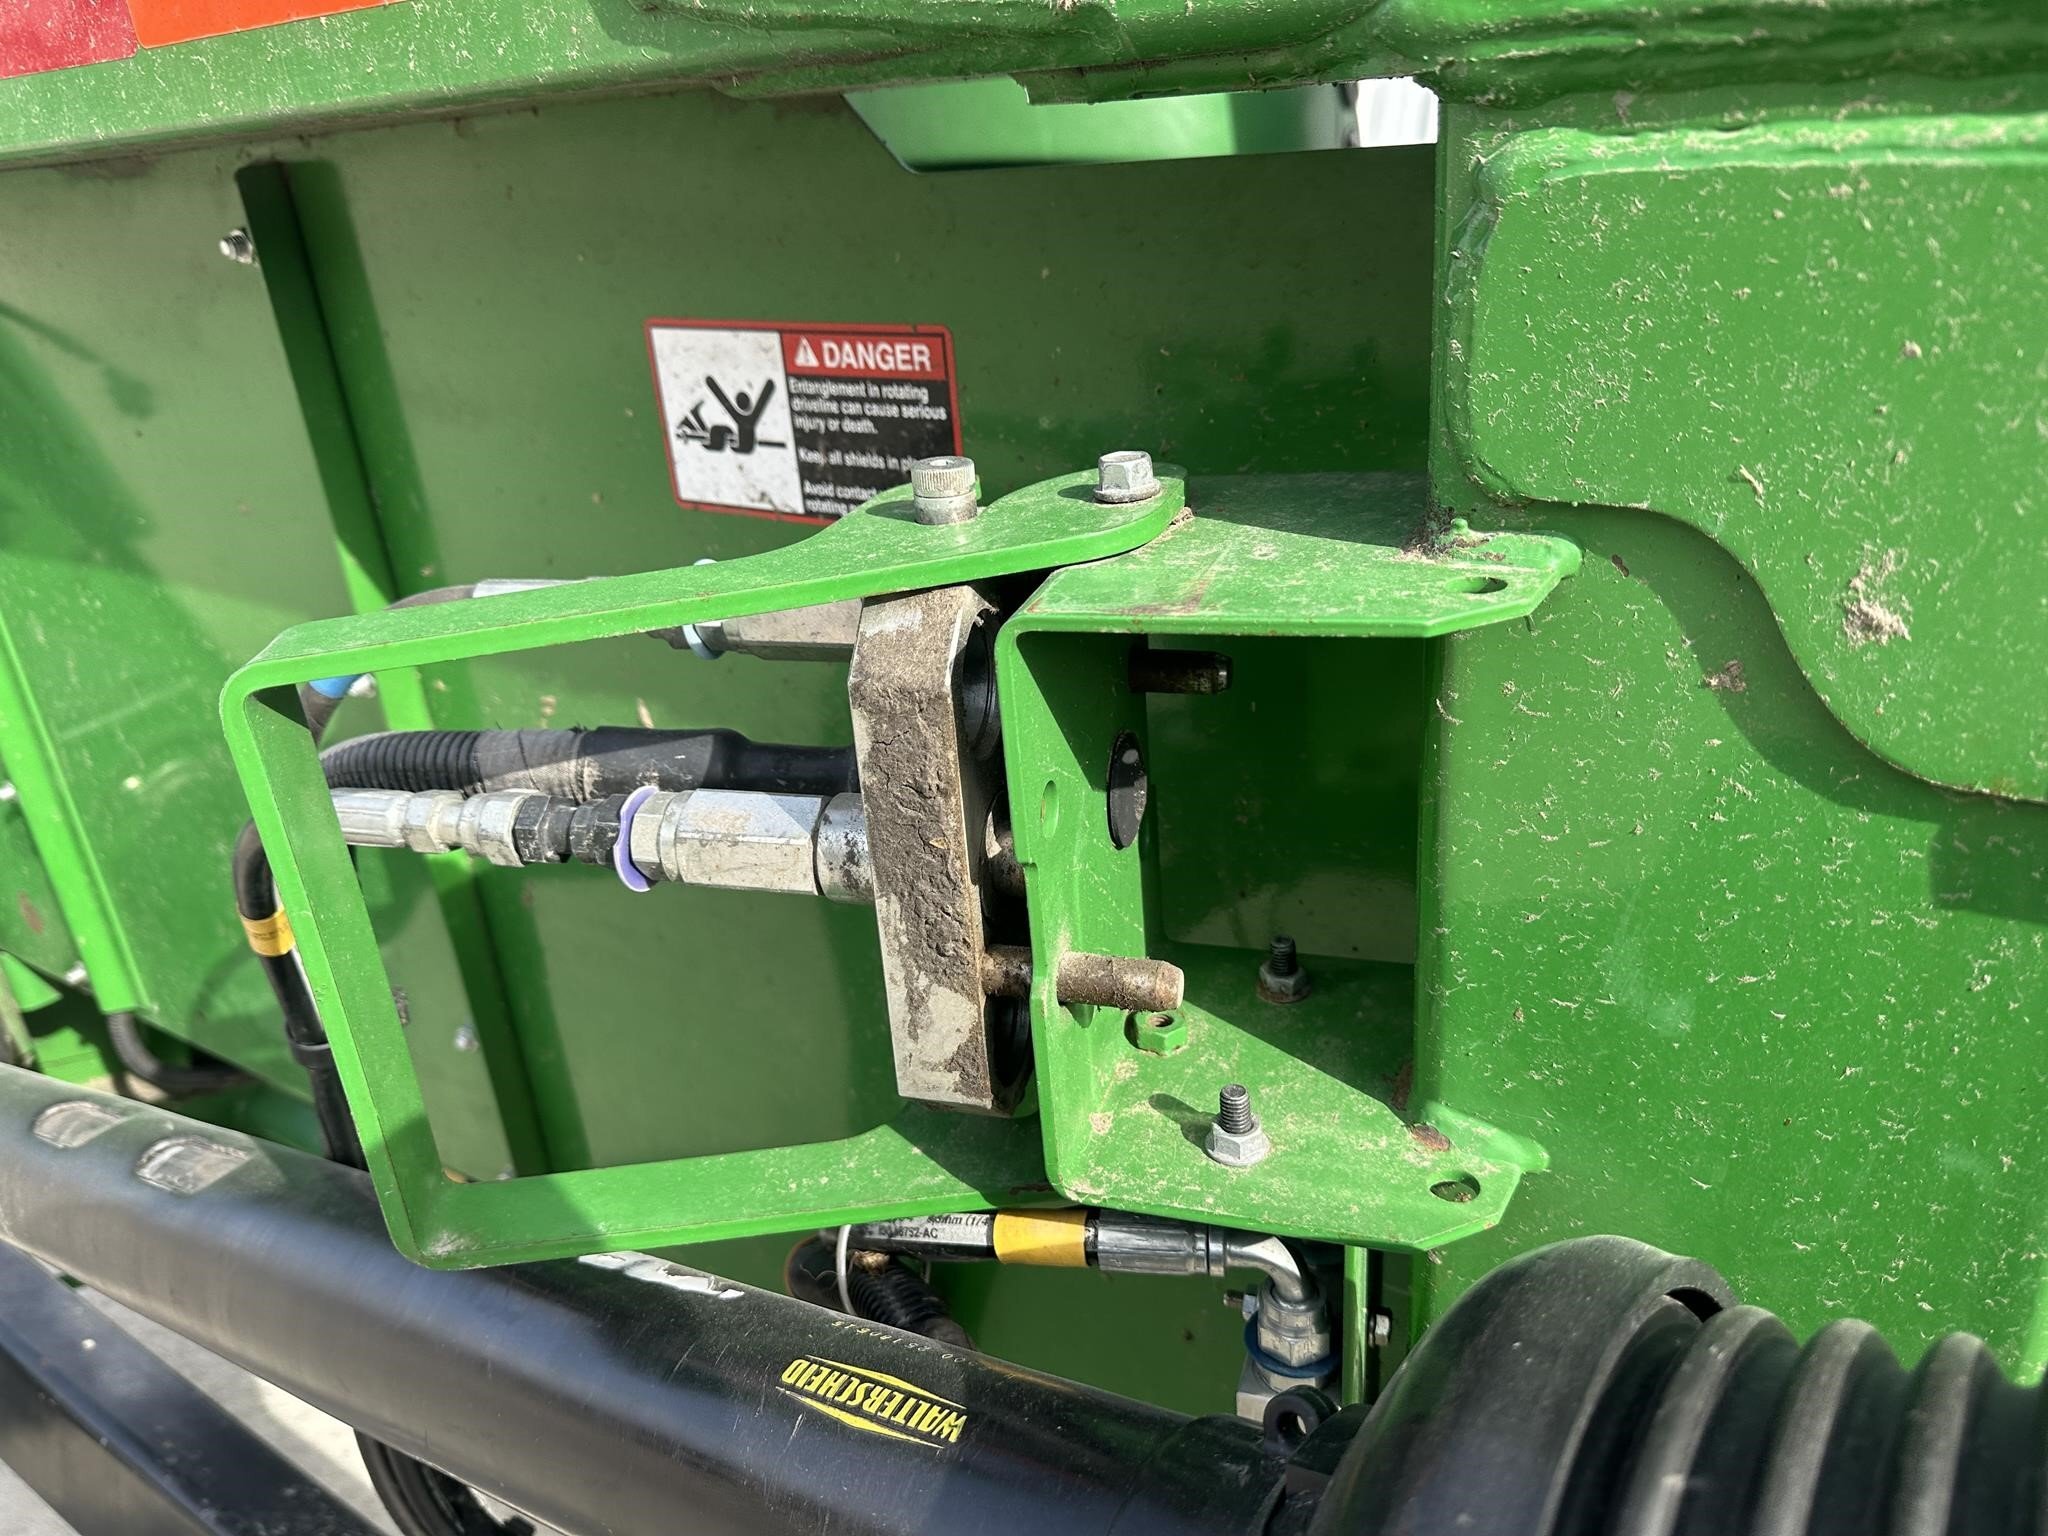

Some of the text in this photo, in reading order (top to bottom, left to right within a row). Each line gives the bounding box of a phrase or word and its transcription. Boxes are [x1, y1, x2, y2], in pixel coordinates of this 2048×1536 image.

[821, 339, 932, 372] DANGER
[788, 377, 929, 404] Entanglement in rotating
[791, 397, 947, 420] driveline can cause serious
[793, 415, 878, 434] injury or death.
[829, 450, 843, 465] all
[844, 451, 885, 469] shields
[886, 455, 899, 469] in
[804, 480, 834, 497] Avoid
[805, 499, 849, 515] rotating
[781, 1359, 968, 1443] WALTERSCHEID
